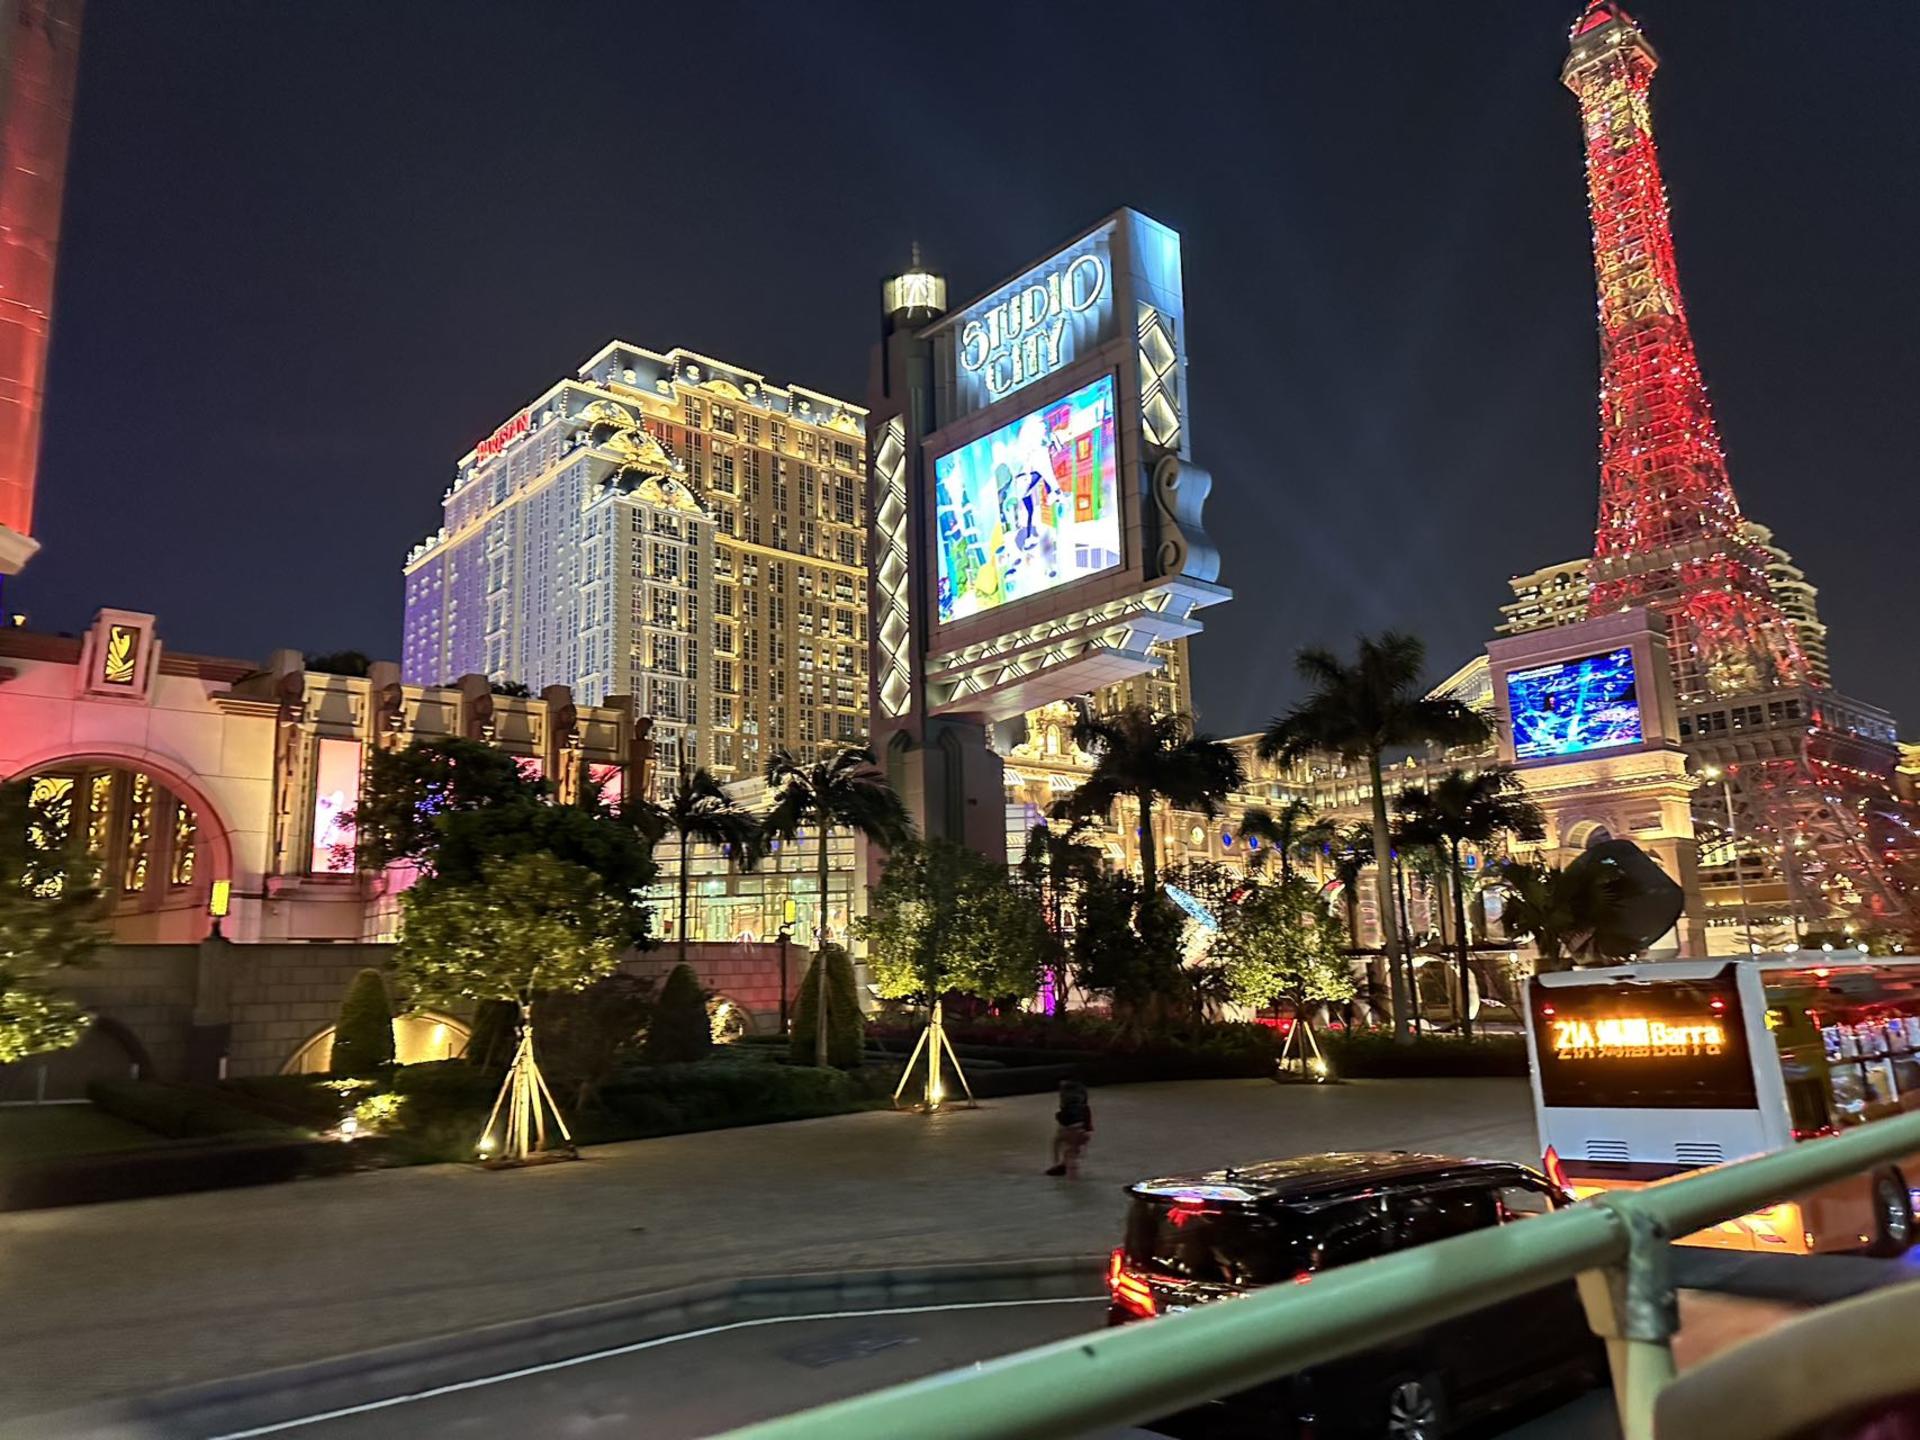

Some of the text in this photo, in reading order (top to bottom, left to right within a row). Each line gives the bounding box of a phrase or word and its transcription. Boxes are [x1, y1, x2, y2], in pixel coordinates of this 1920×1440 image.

[960, 254, 1105, 372] STUDIO
[984, 317, 1066, 394] CITY
[1651, 1021, 1723, 1056] Barra
